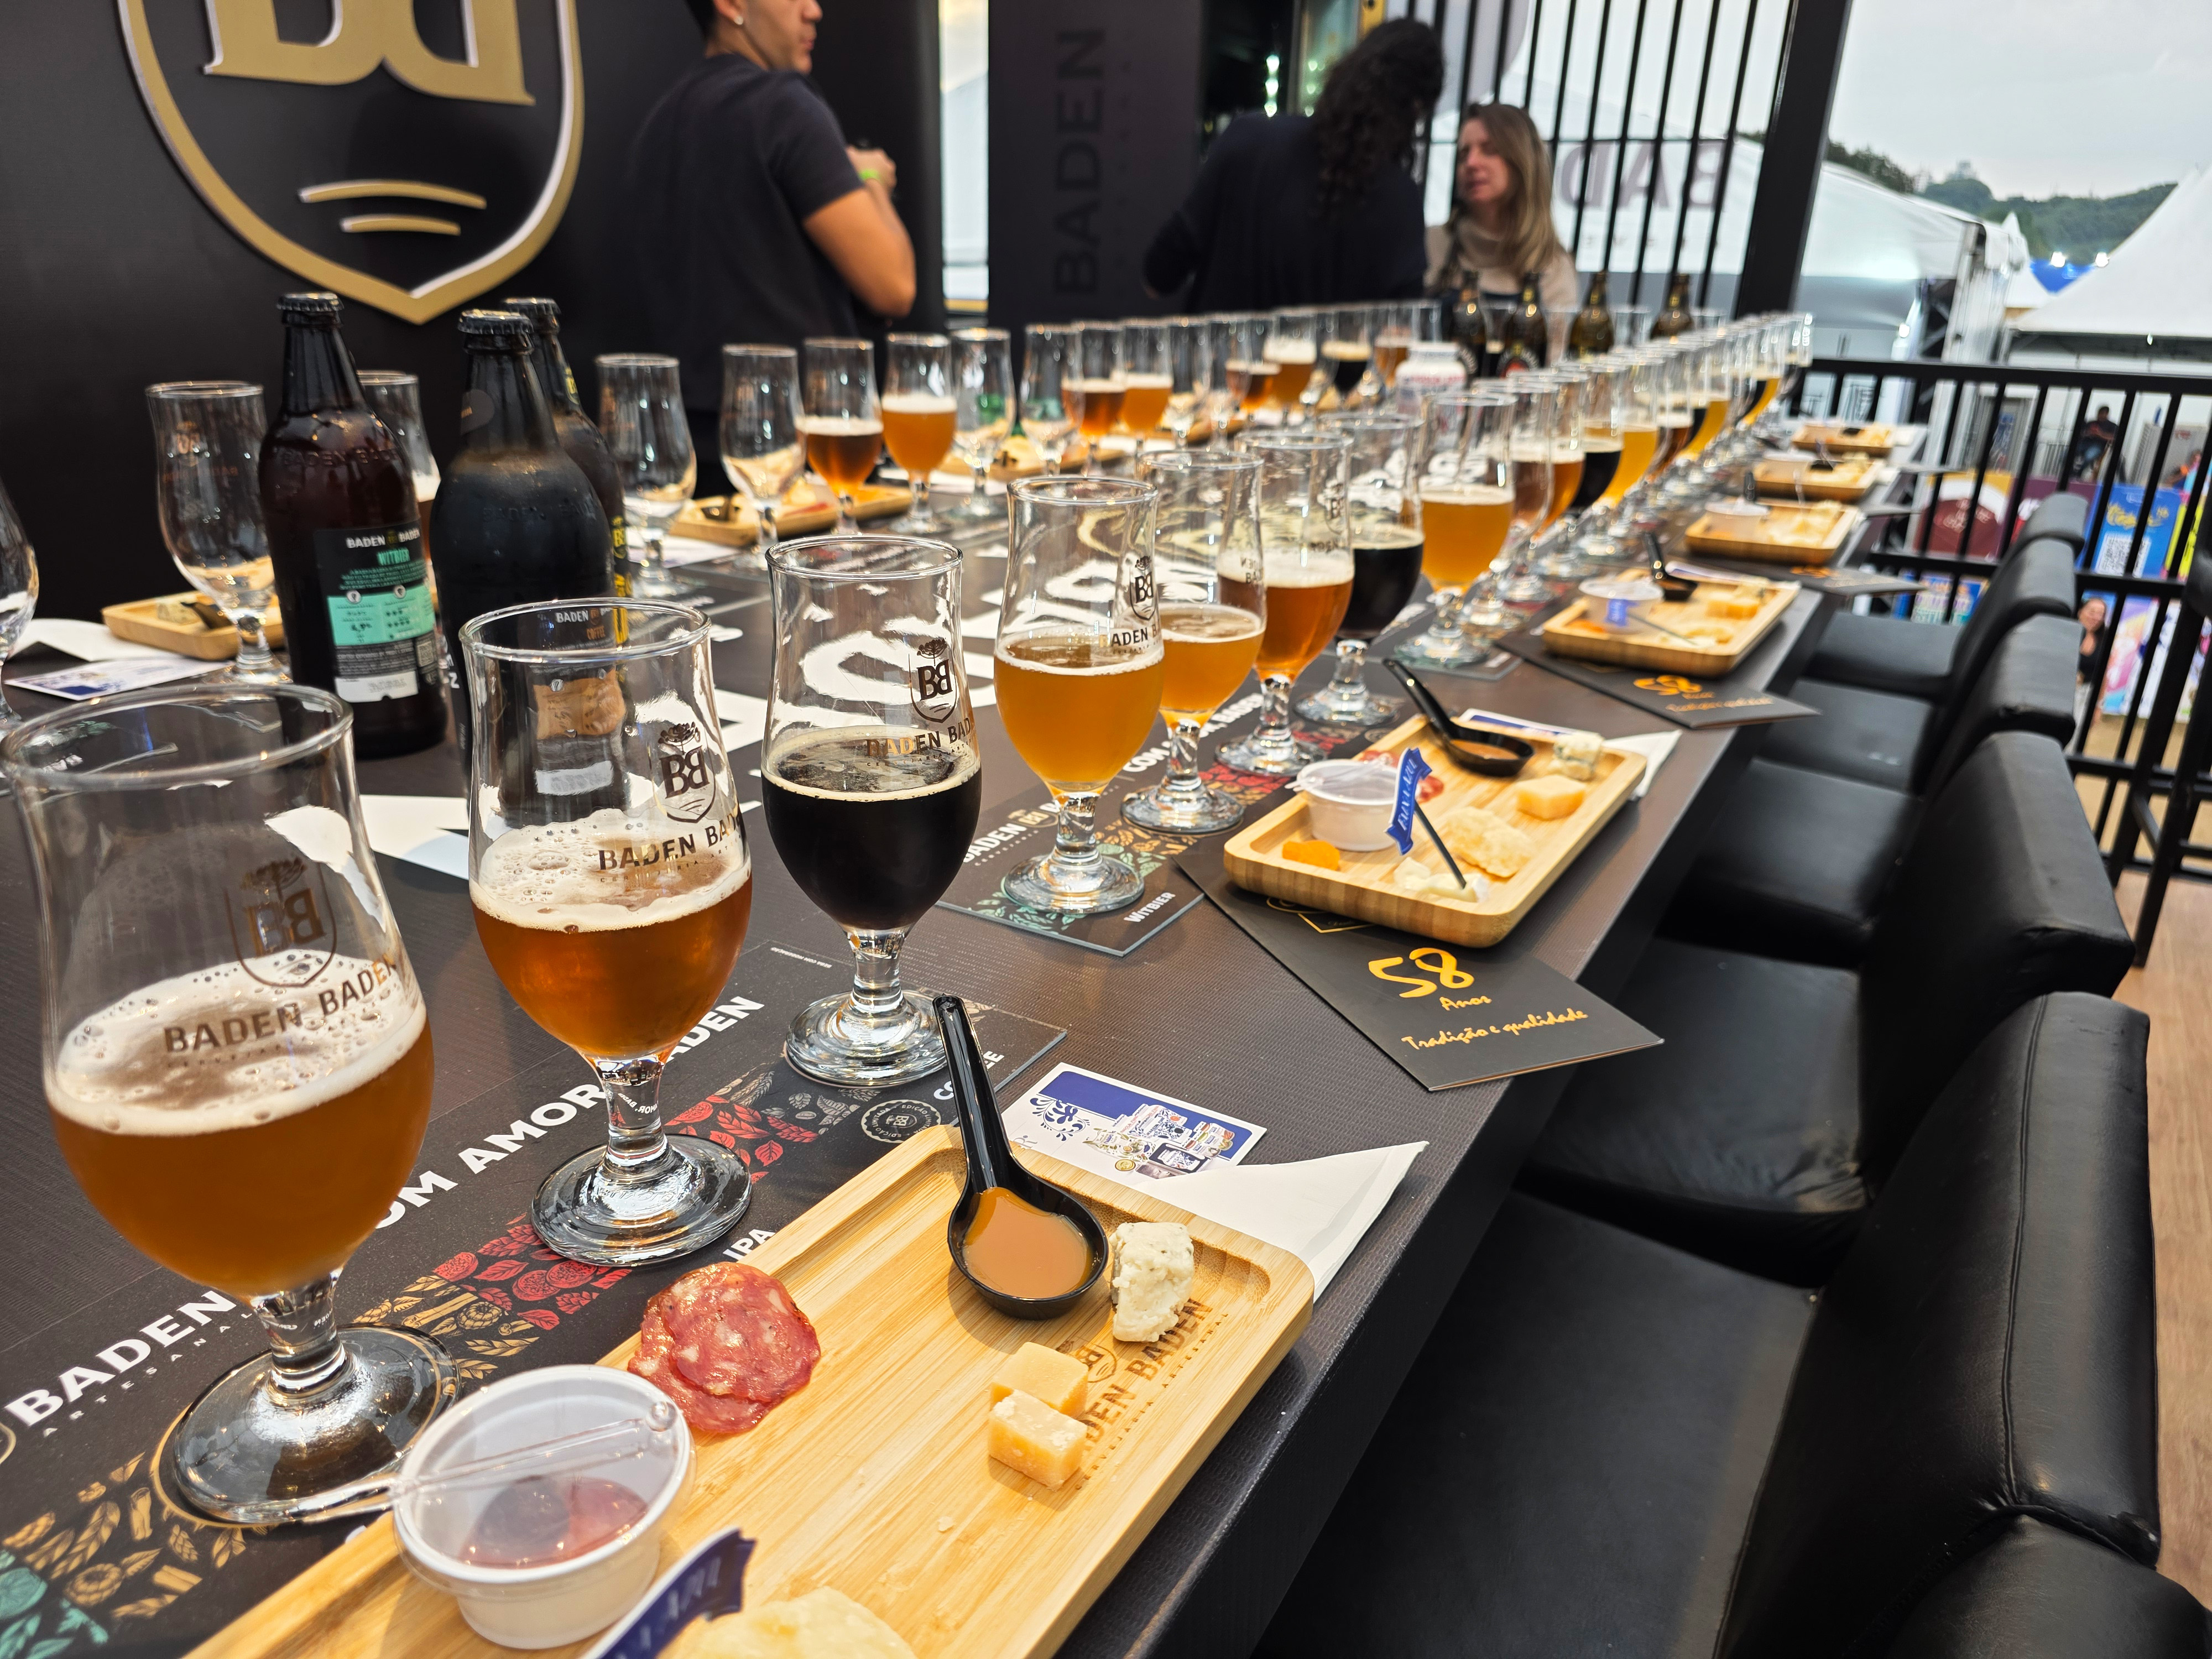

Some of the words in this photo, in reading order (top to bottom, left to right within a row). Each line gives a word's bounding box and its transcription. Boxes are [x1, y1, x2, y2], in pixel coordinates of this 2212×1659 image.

[1054, 30, 1105, 293] BADEN
[346, 536, 386, 549] BADEN
[555, 609, 589, 623] BADEN
[866, 731, 942, 758] BADEN
[947, 717, 972, 744] BAD
[598, 833, 697, 870] BADEN
[1123, 892, 1176, 922] WITBIER
[1368, 947, 1475, 998] 58
[1439, 995, 1493, 1011] Anos
[164, 1002, 305, 1053] BADEN
[1401, 1027, 1489, 1050] Tradição
[1489, 1025, 1501, 1034] e
[1502, 1007, 1589, 1036] qualidade
[375, 1170, 458, 1229] OM
[665, 996, 765, 1064] ADEN
[871, 1107, 891, 1128] LIMITADA
[901, 1104, 928, 1115] EDIÇÃO
[875, 1128, 902, 1138] EDIÇÃO
[722, 1229, 776, 1261] IPA
[2, 1290, 237, 1427] BADEN
[43, 1312, 253, 1438] ARTESANAL
[1075, 1401, 1154, 1490] CERVEJARIA
[1161, 1312, 1229, 1389] ARTESANAL
[1082, 1383, 1137, 1452] DEN
